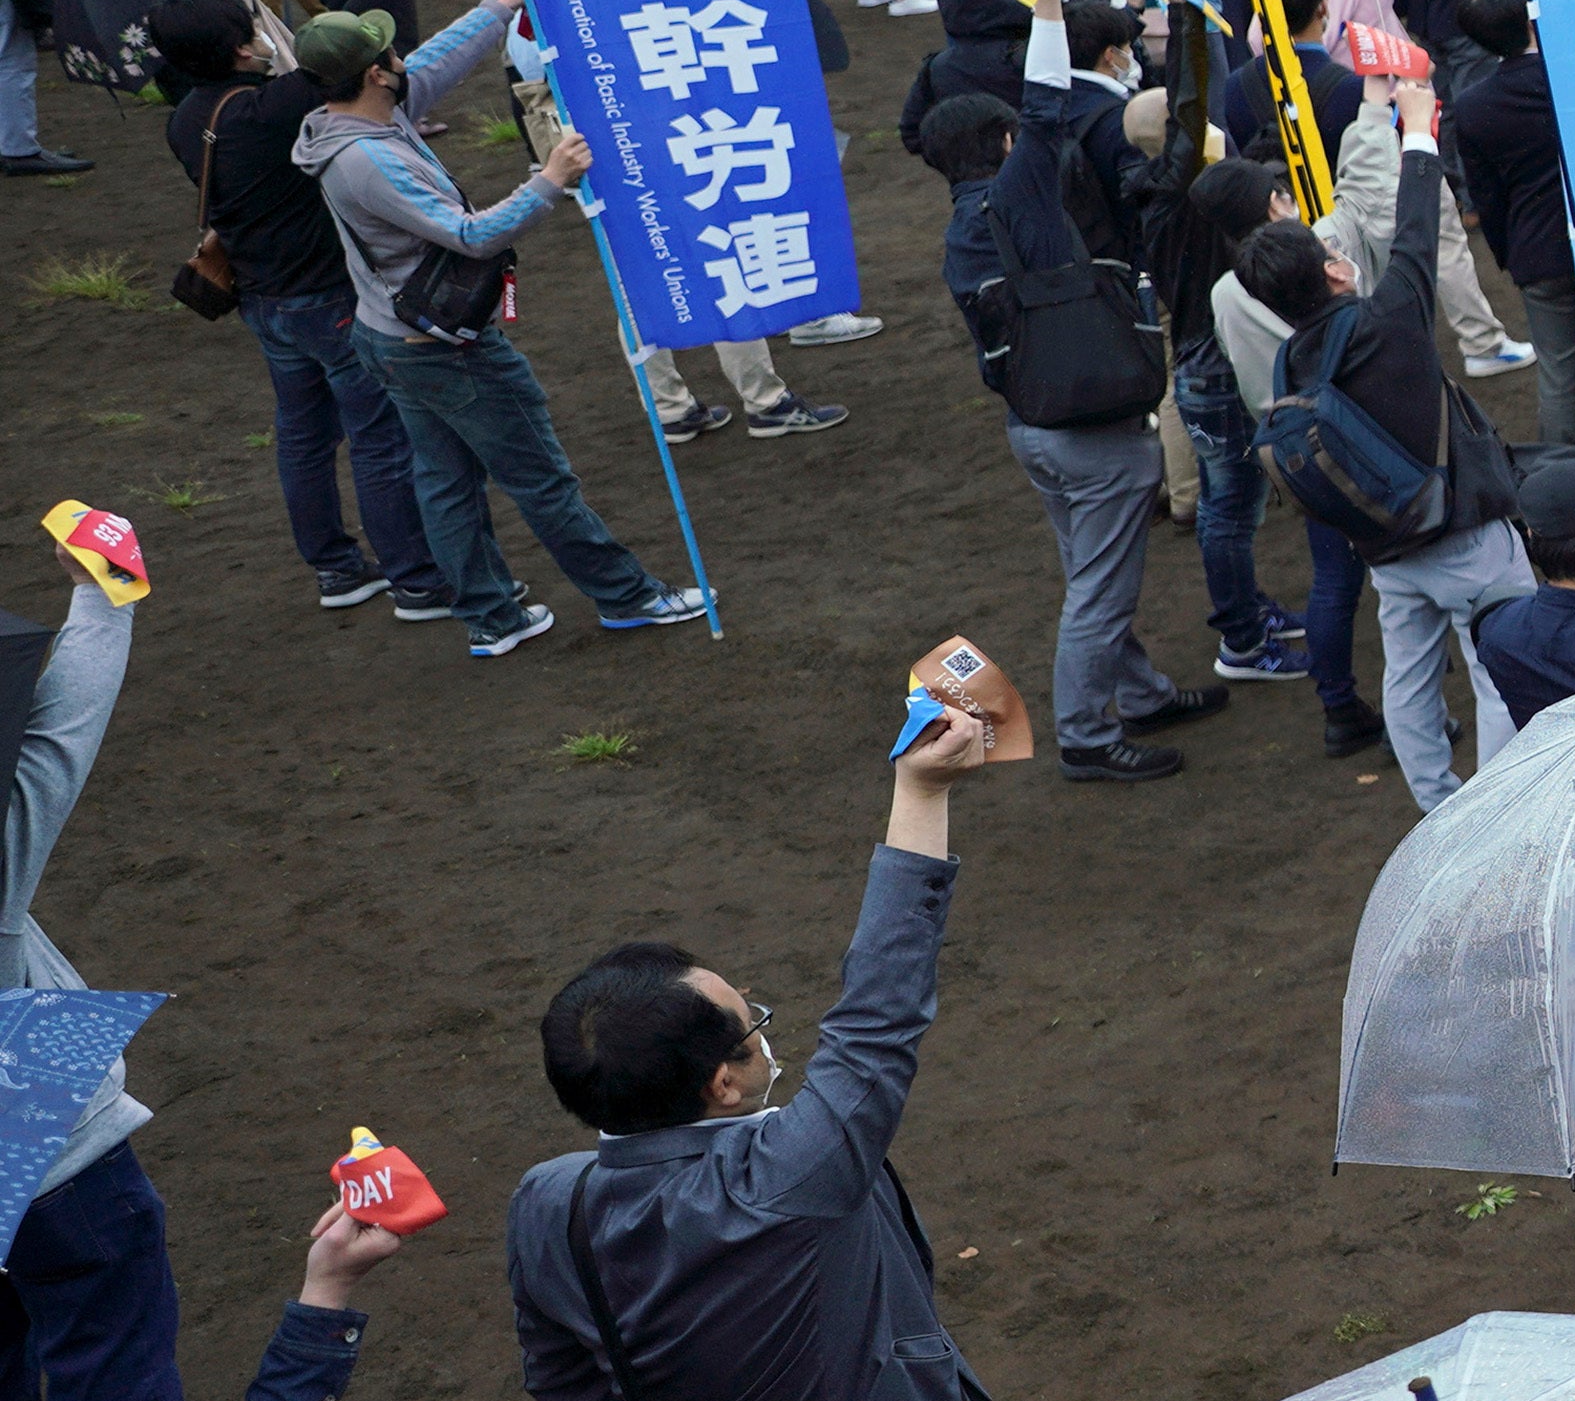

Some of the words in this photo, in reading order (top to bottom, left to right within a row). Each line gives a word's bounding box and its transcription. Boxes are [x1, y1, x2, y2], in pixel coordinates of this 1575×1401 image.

[586, 51, 606, 75] of
[594, 72, 622, 120] Basic
[609, 119, 647, 188] Industry
[636, 190, 680, 263] Workers'
[662, 265, 693, 324] Unions
[349, 1166, 395, 1210] DAY
